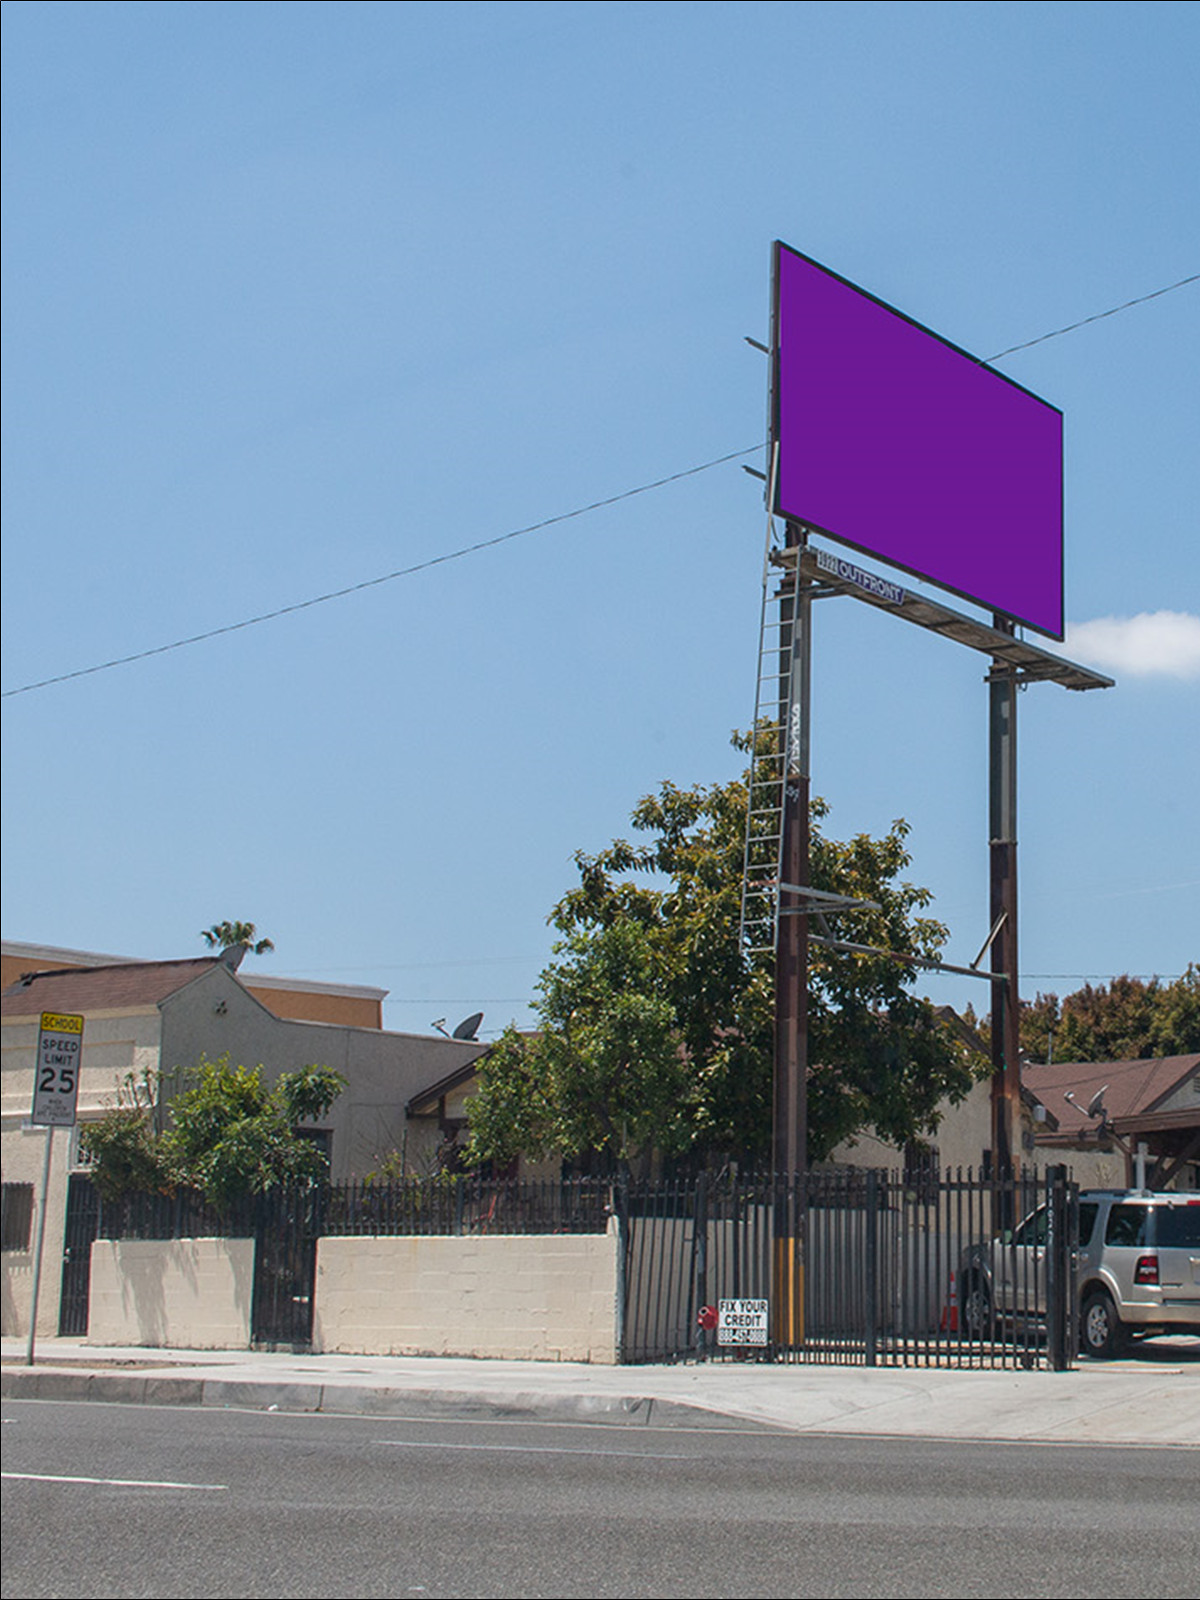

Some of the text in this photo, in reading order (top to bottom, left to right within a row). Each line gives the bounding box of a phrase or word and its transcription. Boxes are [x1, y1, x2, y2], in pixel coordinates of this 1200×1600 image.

[839, 563, 901, 601] OUTFRONT
[43, 1016, 80, 1031] SCHOOL
[42, 1039, 78, 1051] SPEED
[44, 1054, 73, 1066] LIMIT
[39, 1067, 75, 1094] 25
[720, 1301, 767, 1313] FIX YOUR
[725, 1314, 762, 1327] CREDIT
